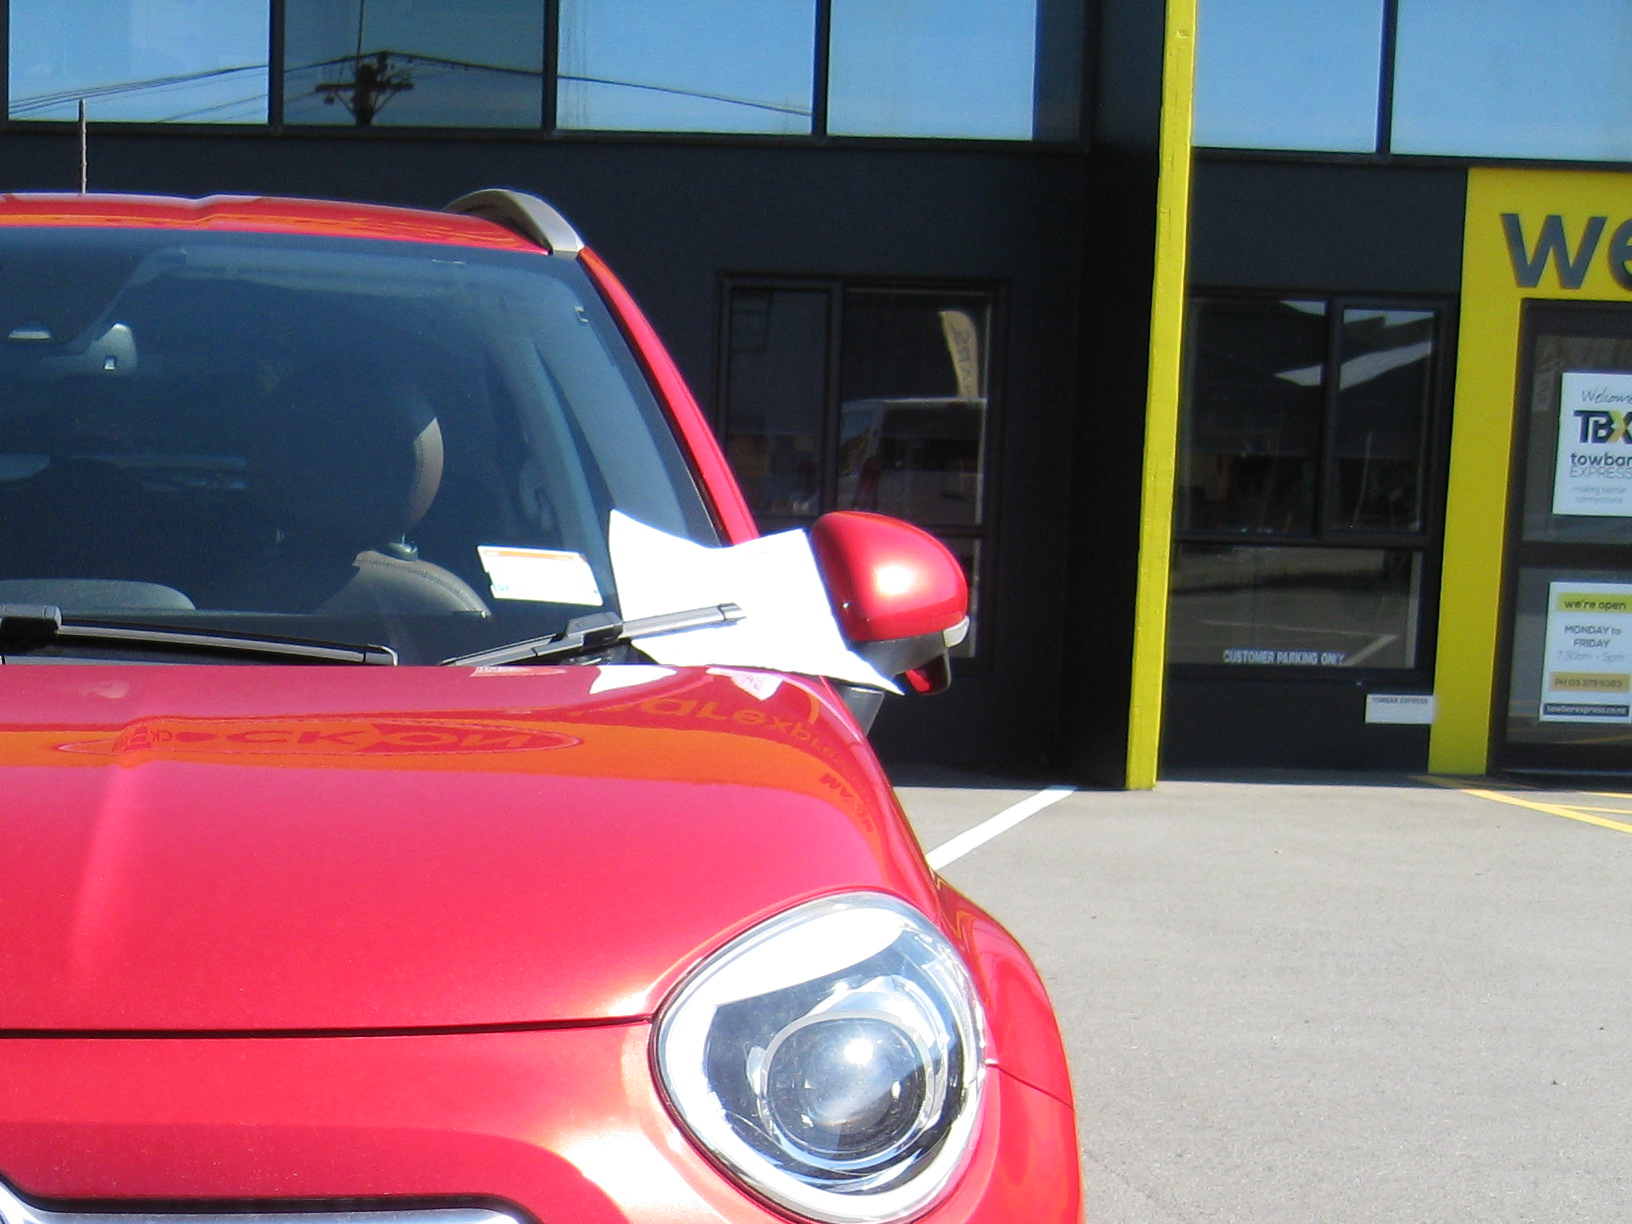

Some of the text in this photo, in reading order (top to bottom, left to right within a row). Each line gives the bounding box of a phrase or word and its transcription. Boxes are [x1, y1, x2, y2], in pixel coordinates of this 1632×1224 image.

[1570, 467, 1632, 479] EXPRESS
[1564, 600, 1626, 612] we're open
[1564, 625, 1622, 635] MONDAY to
[1573, 638, 1611, 648] FRIDAY
[1223, 649, 1275, 665] CUSTOMER
[1277, 651, 1318, 665] PARKING
